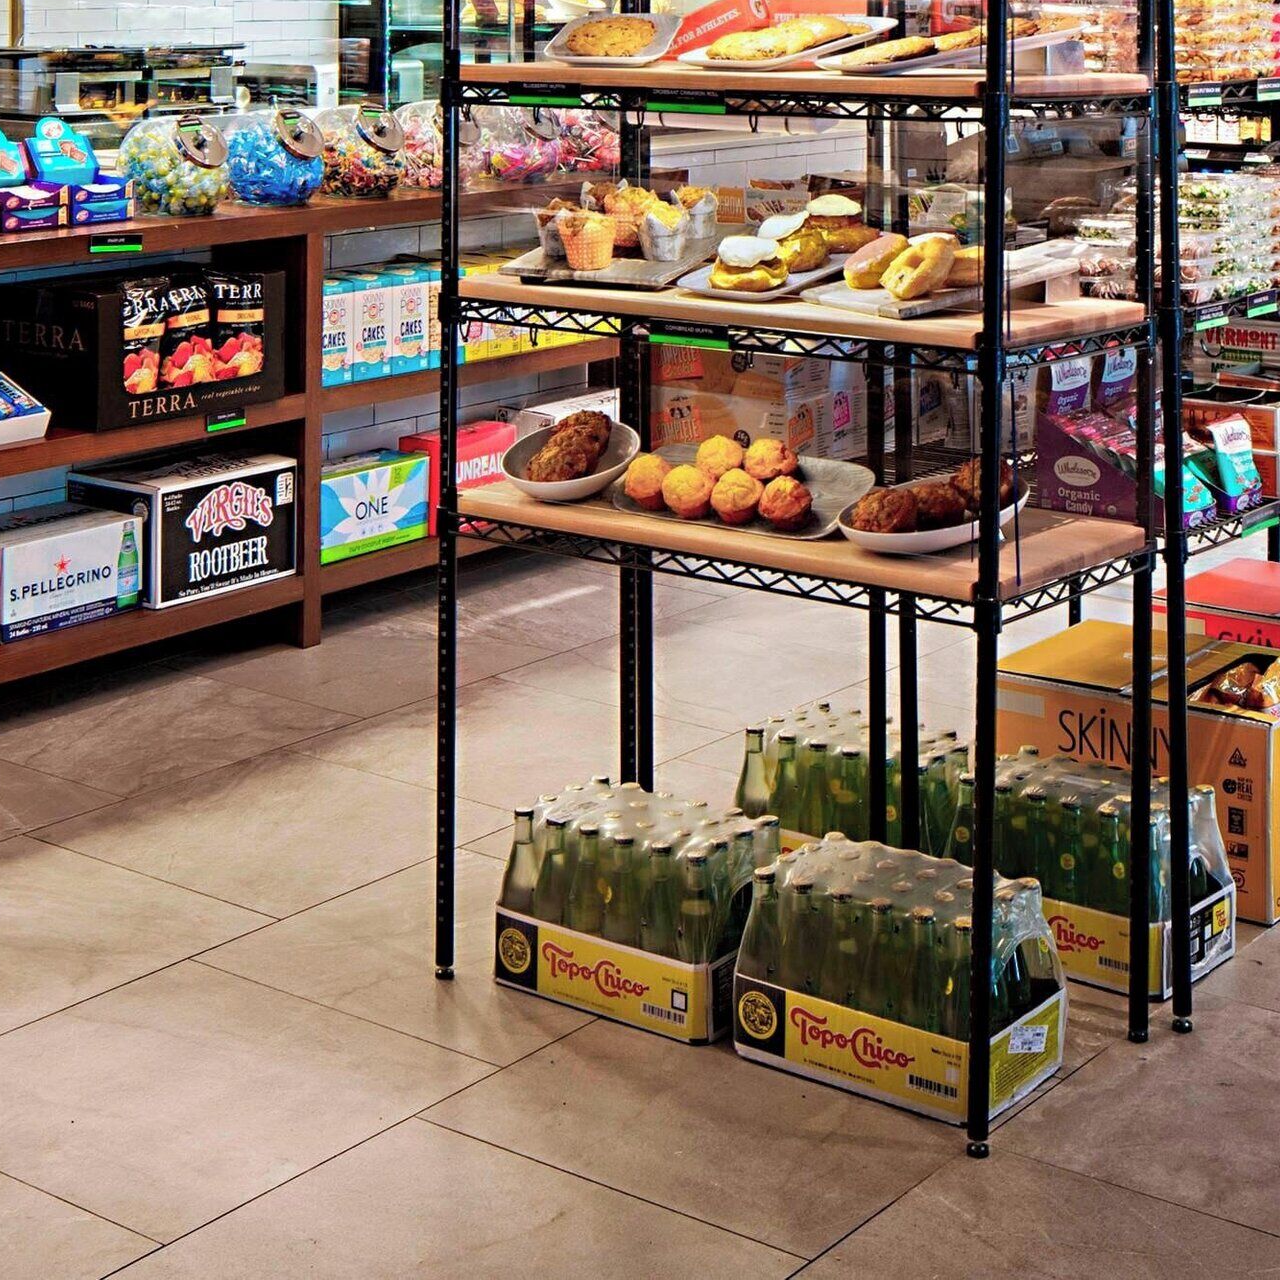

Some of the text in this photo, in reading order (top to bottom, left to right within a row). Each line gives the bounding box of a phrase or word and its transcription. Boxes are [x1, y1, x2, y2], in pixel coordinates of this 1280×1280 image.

[3, 320, 86, 352] TERRA
[362, 325, 386, 342] CAKES
[400, 320, 422, 336] CAKES
[129, 392, 196, 419] TERRA
[1058, 487, 1101, 500] Organic
[355, 496, 389, 521] ONE
[1066, 500, 1093, 516] Candy
[189, 535, 269, 583] ROOTBEER
[10, 566, 111, 602] S.PELLEGRINO
[542, 941, 650, 998] Topo Chico
[790, 1007, 915, 1069] Topo Chico
